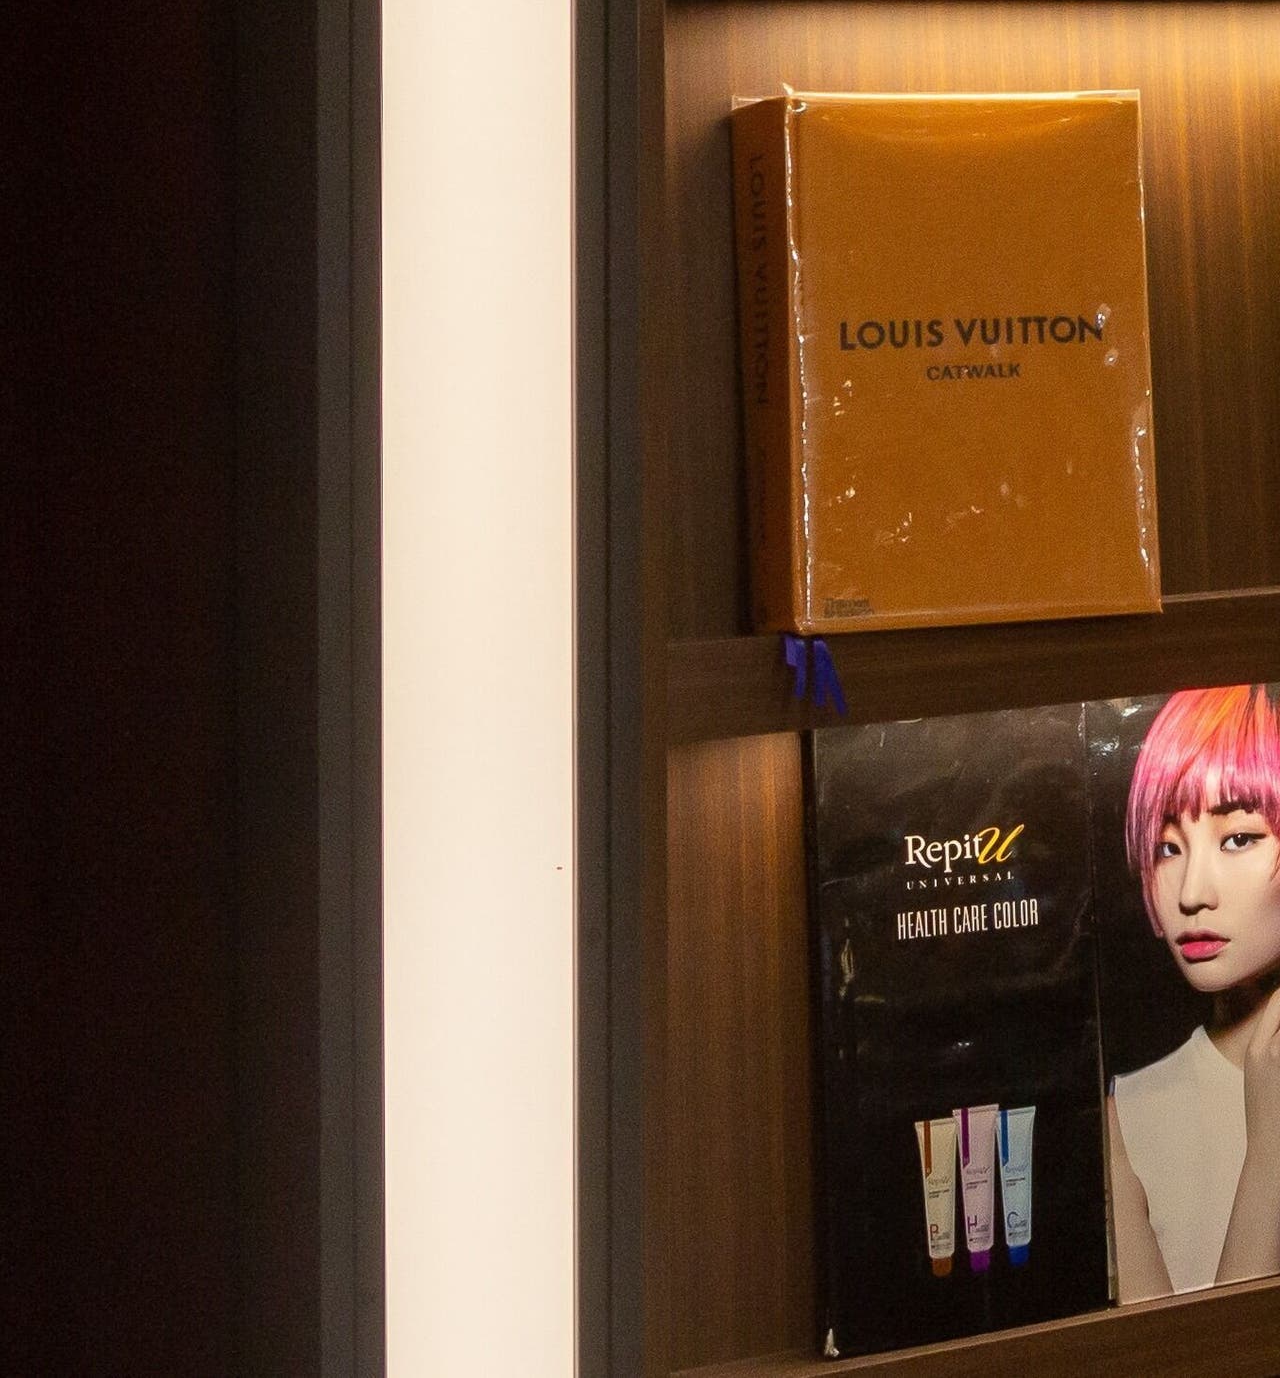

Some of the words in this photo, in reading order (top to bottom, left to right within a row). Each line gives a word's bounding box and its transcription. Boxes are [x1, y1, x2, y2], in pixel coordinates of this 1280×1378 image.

[838, 318, 944, 352] LOUIS
[956, 314, 1104, 349] VUITTON
[926, 361, 1022, 382] CATWALK
[906, 870, 1014, 890] UNIVERSAL
[897, 908, 948, 940] HEALTH
[953, 903, 988, 934] CARE
[994, 898, 1039, 930] COLOR
